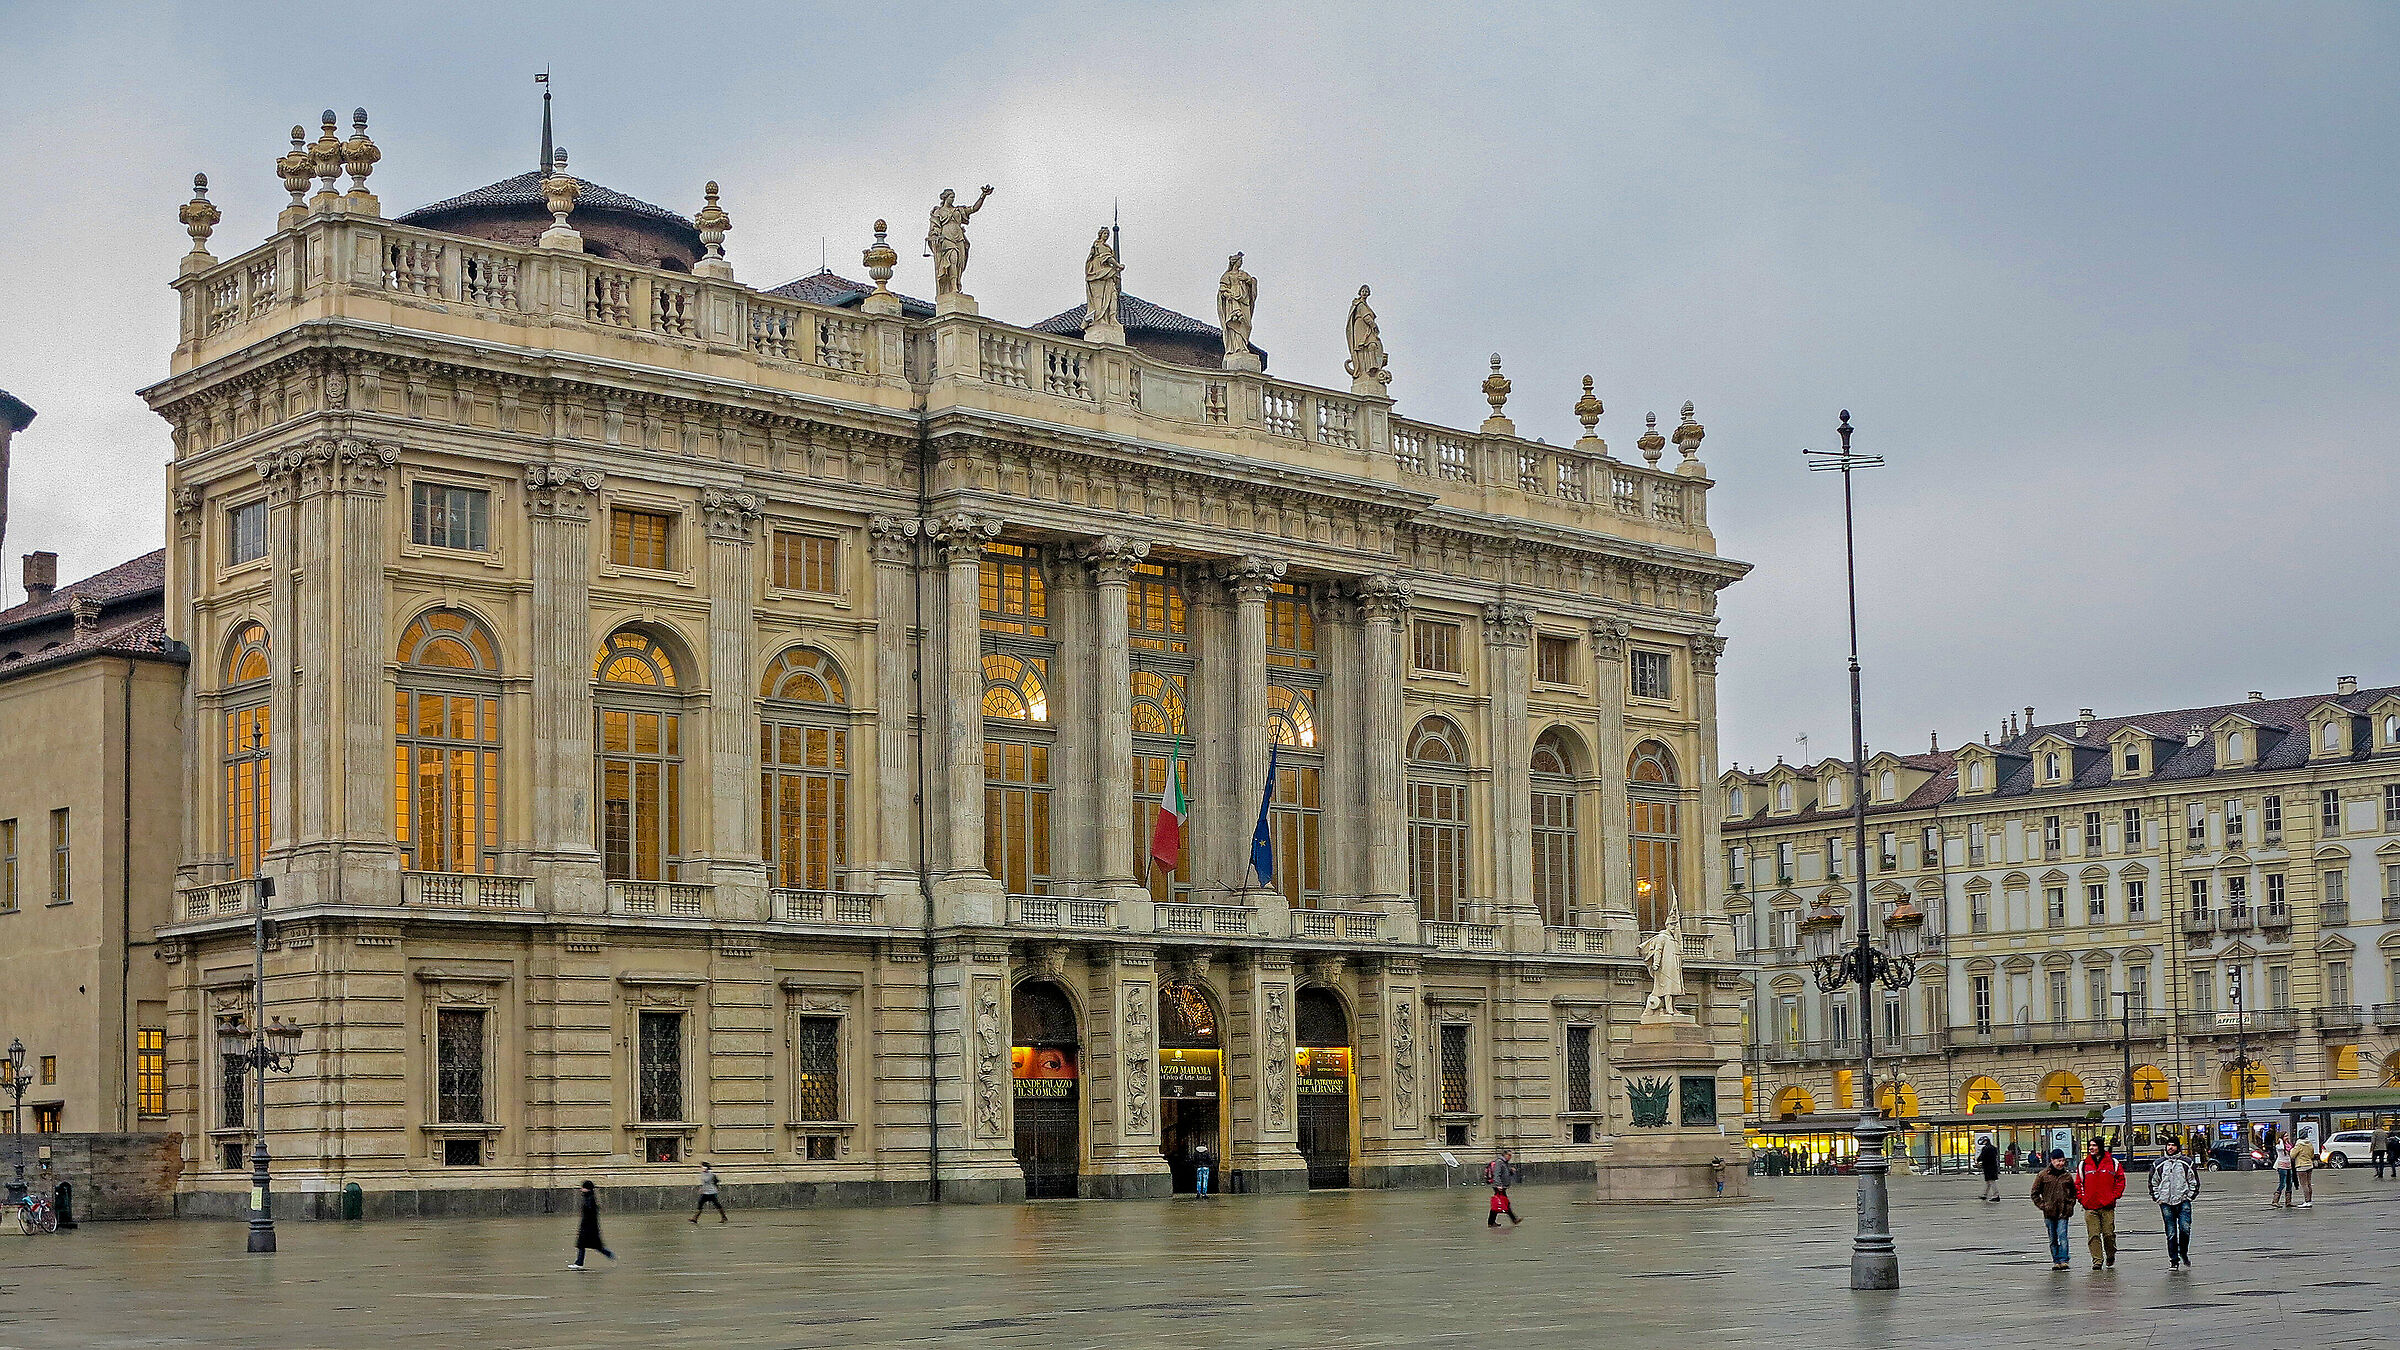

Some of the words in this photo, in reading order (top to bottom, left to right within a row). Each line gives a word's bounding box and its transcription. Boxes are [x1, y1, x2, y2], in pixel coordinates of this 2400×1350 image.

[1179, 1066, 1211, 1075] MADAMA
[1042, 1079, 1072, 1089] PALAZZO
[1310, 1084, 1344, 1093] ALBANESE
[1027, 1087, 1042, 1096] SUO
[1043, 1087, 1067, 1097] MUSEO
